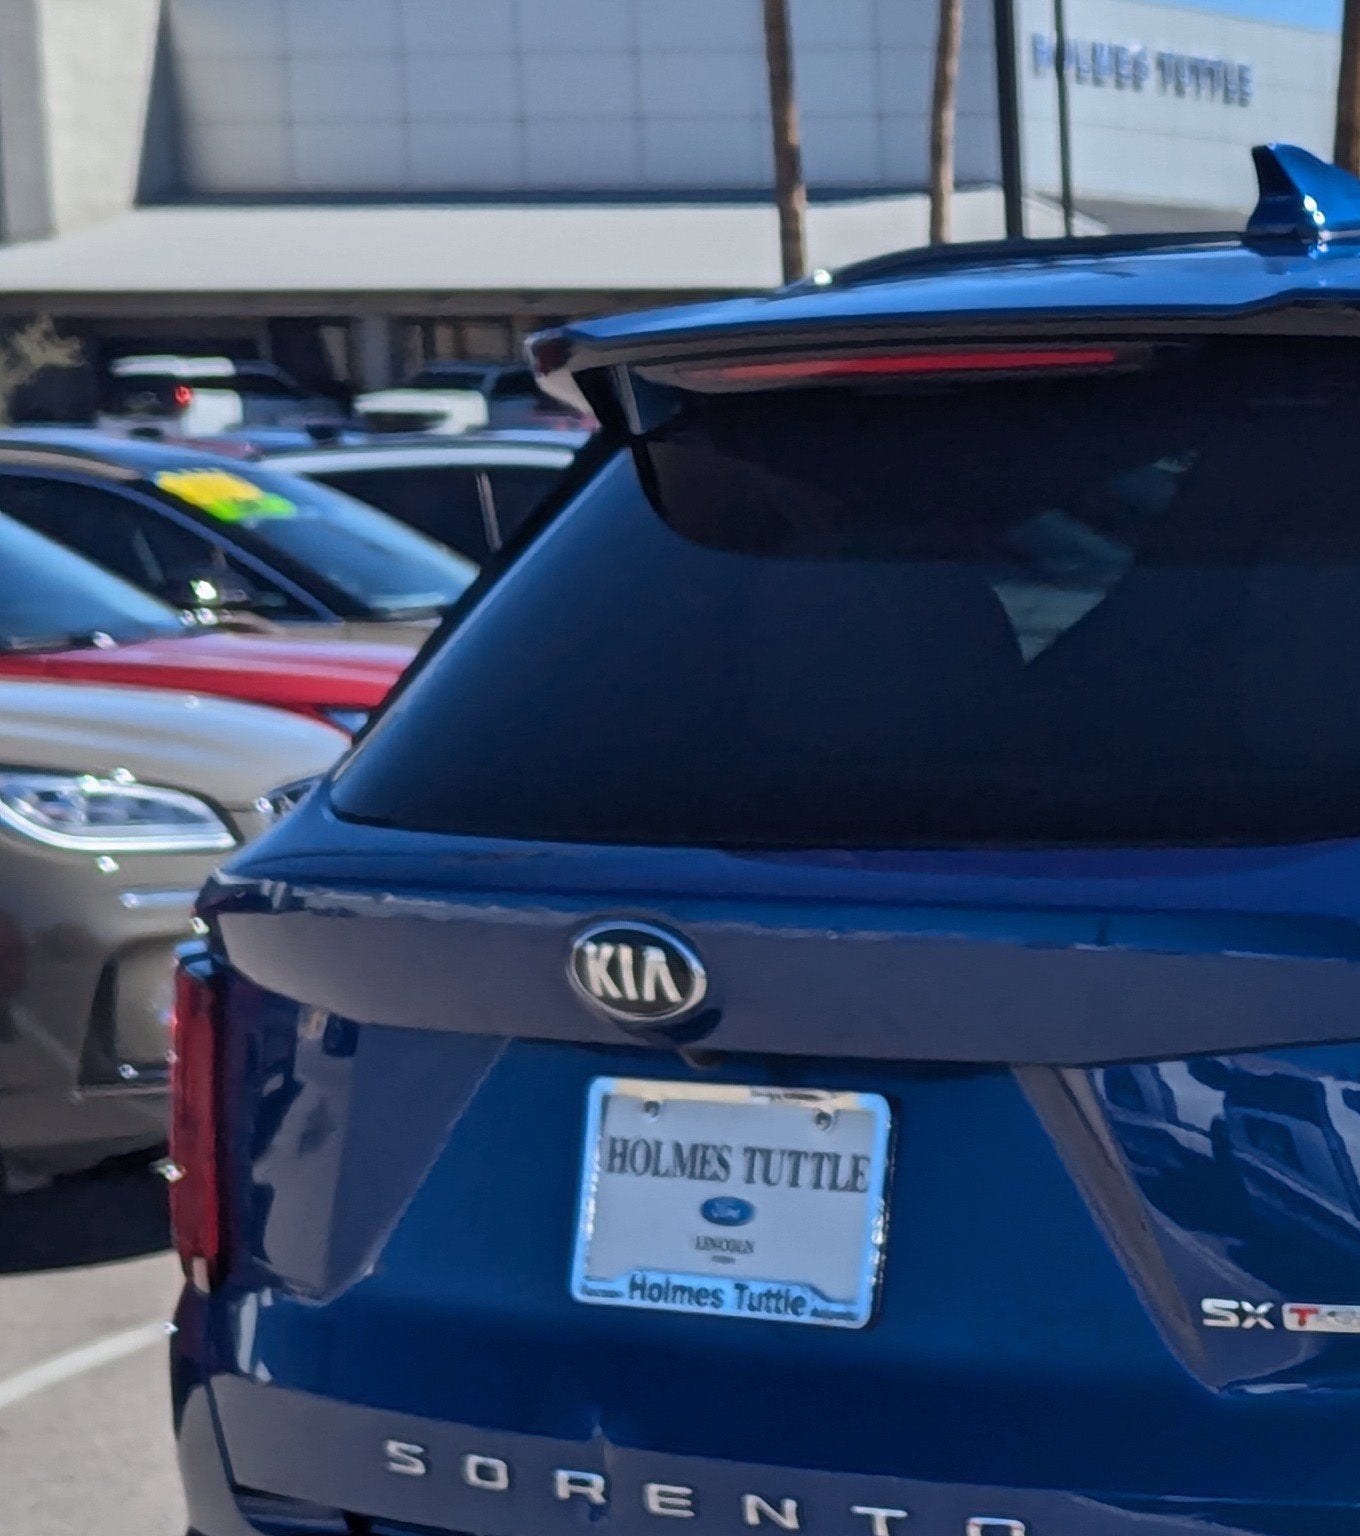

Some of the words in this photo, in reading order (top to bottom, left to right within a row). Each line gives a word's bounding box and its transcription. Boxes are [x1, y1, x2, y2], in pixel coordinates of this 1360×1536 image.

[1156, 51, 1254, 107] TUTTLE
[585, 941, 683, 1002] KIA
[606, 1136, 733, 1183] HOLMES
[742, 1146, 871, 1194] TUTTLE
[628, 1272, 725, 1309] Holmes
[733, 1282, 808, 1316] Tuttle
[1200, 1297, 1275, 1330] SX
